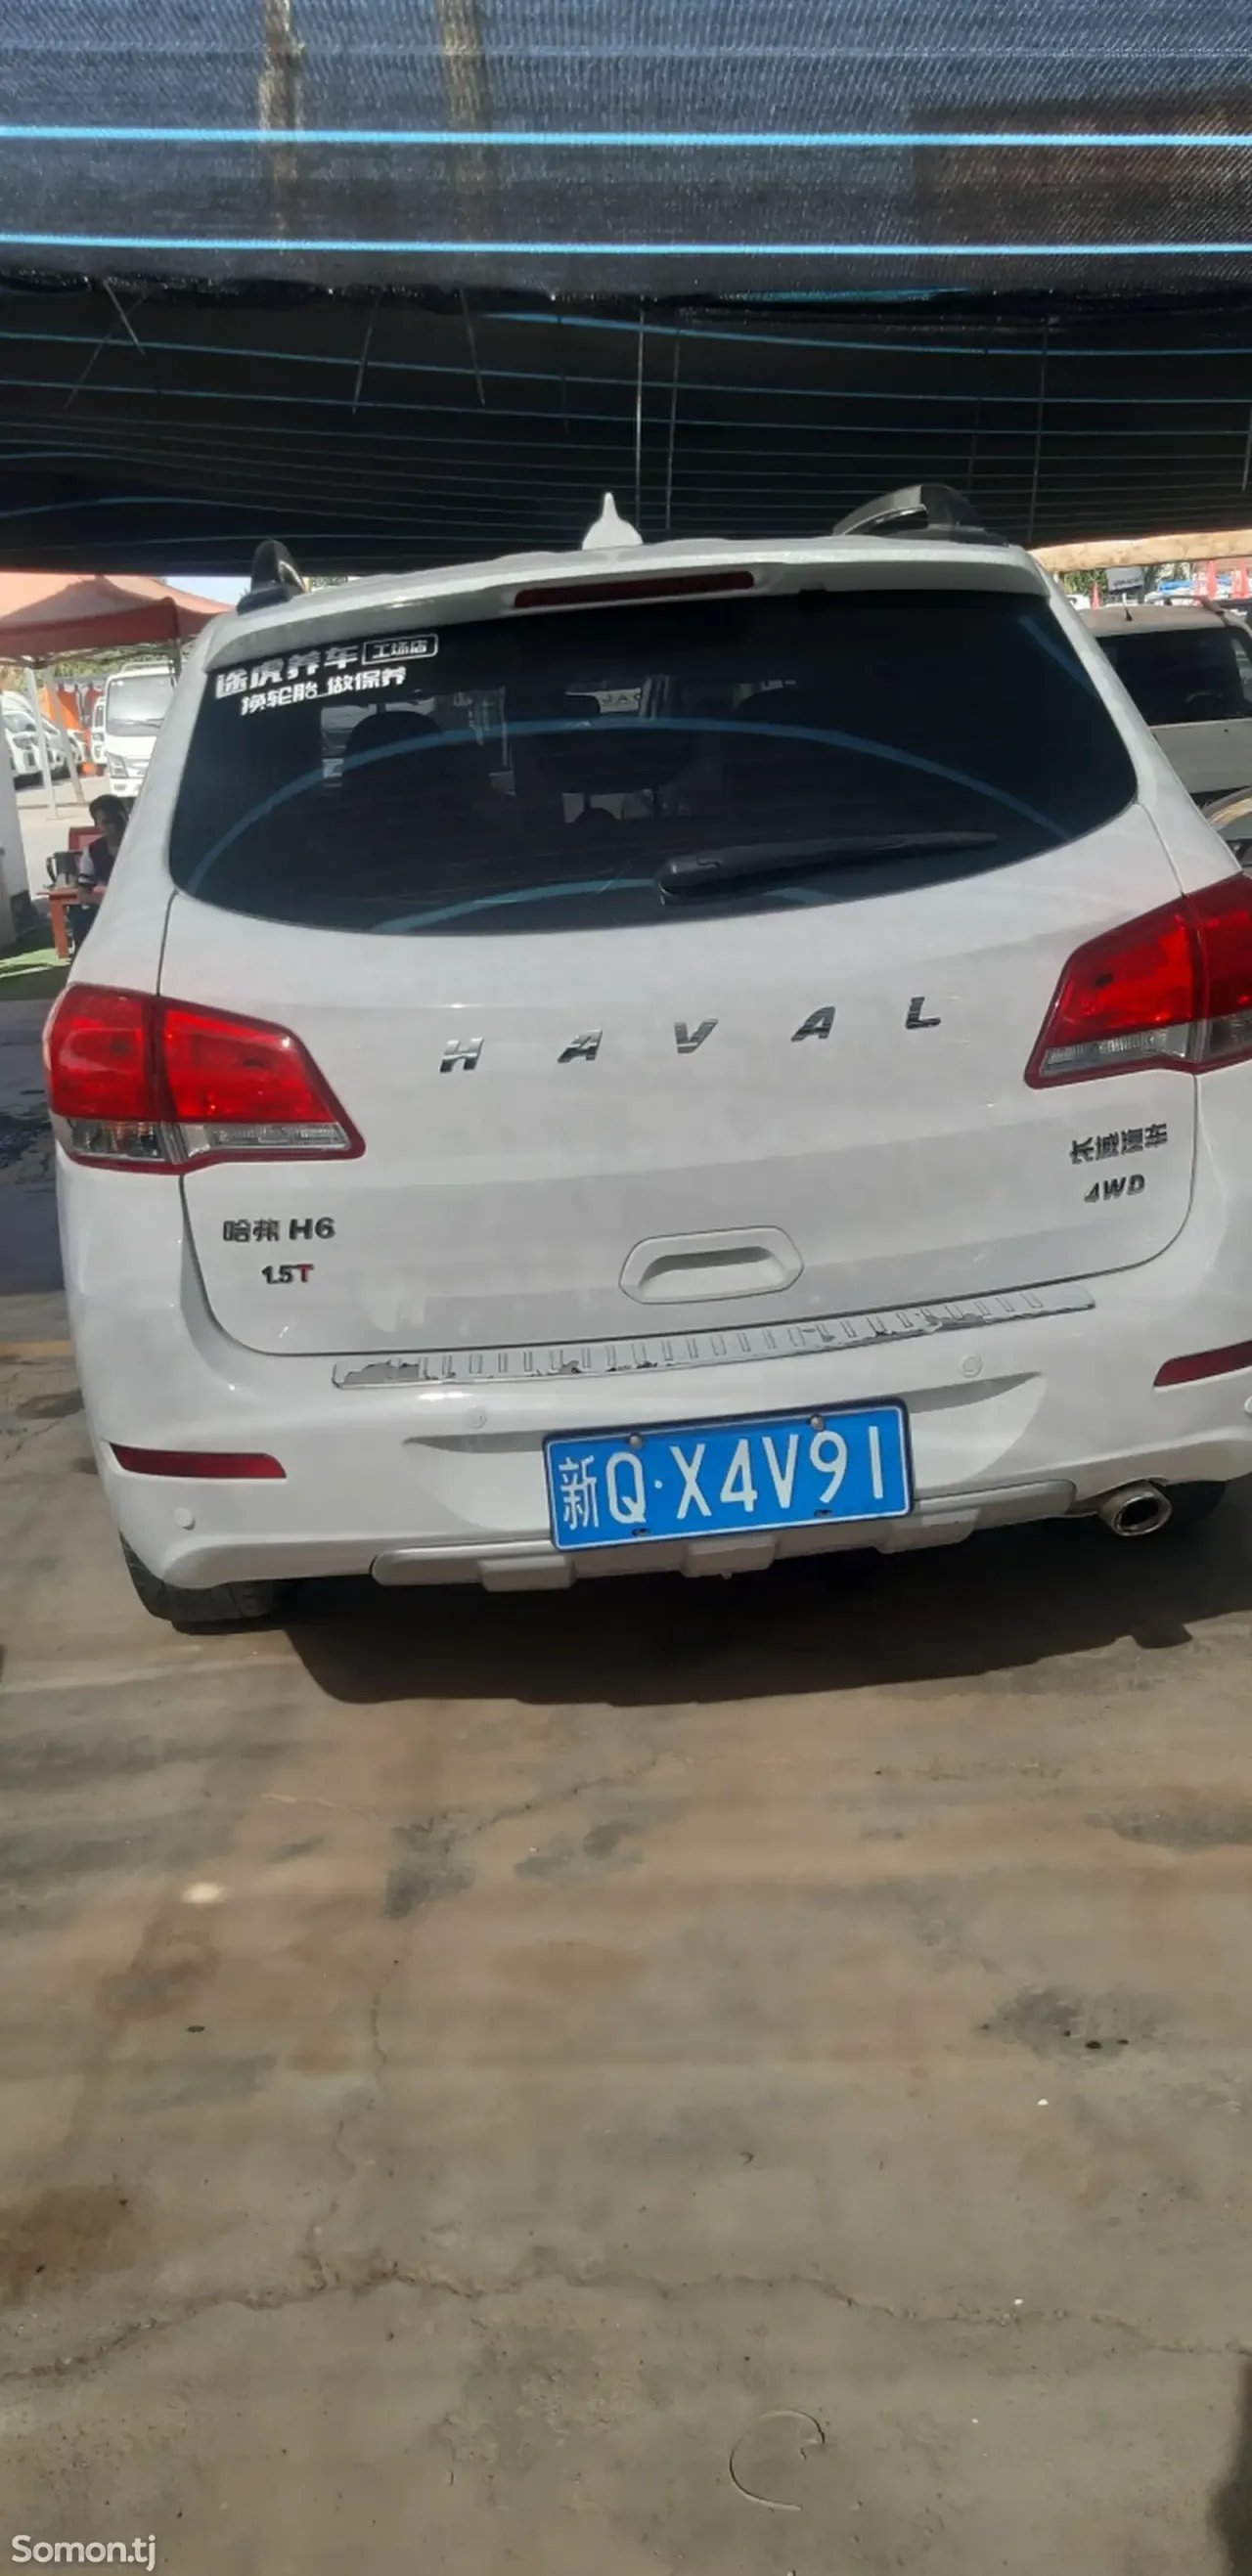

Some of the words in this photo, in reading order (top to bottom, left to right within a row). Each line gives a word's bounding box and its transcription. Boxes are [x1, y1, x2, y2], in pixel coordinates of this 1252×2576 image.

[215, 644, 359, 699] 途虎养车
[439, 996, 942, 1074] HAVAL
[1084, 1174, 1145, 1203] 4WD
[289, 1217, 335, 1240] H6
